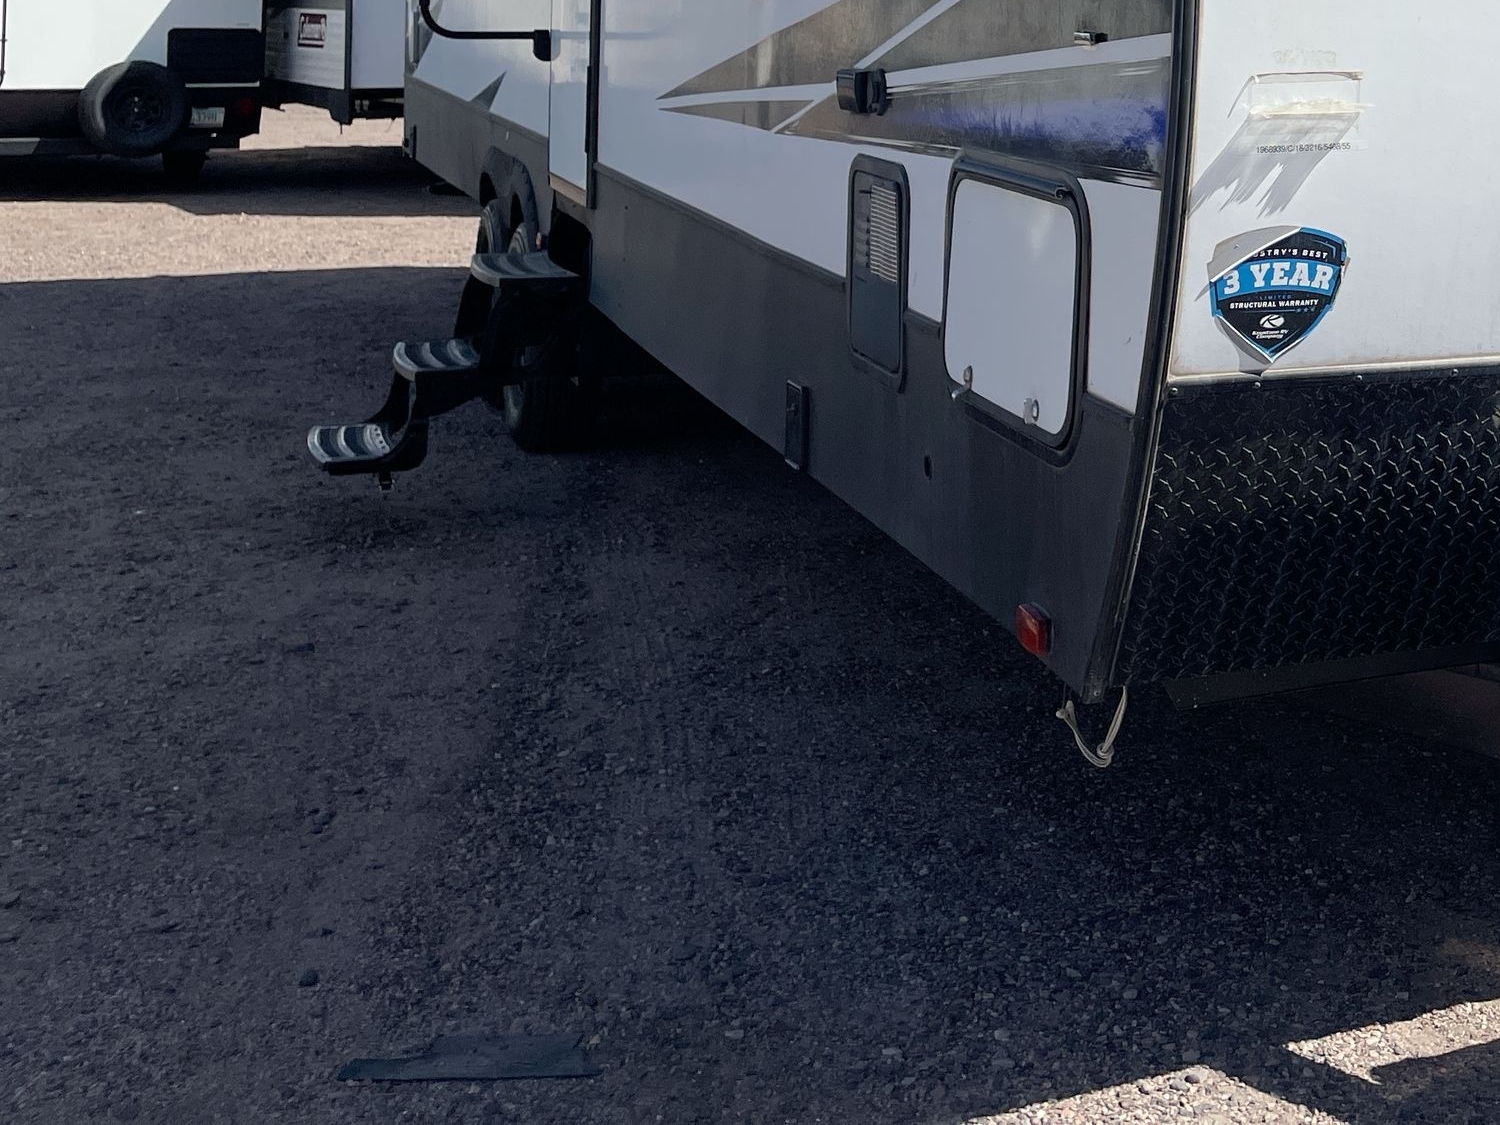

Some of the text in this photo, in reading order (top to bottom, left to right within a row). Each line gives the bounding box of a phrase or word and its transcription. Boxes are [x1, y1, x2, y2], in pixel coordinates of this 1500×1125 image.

[1302, 250, 1328, 259] BEST
[1223, 261, 1333, 295] 3 YEAR
[1230, 299, 1319, 309] STRUCTURAL WARRANTY
